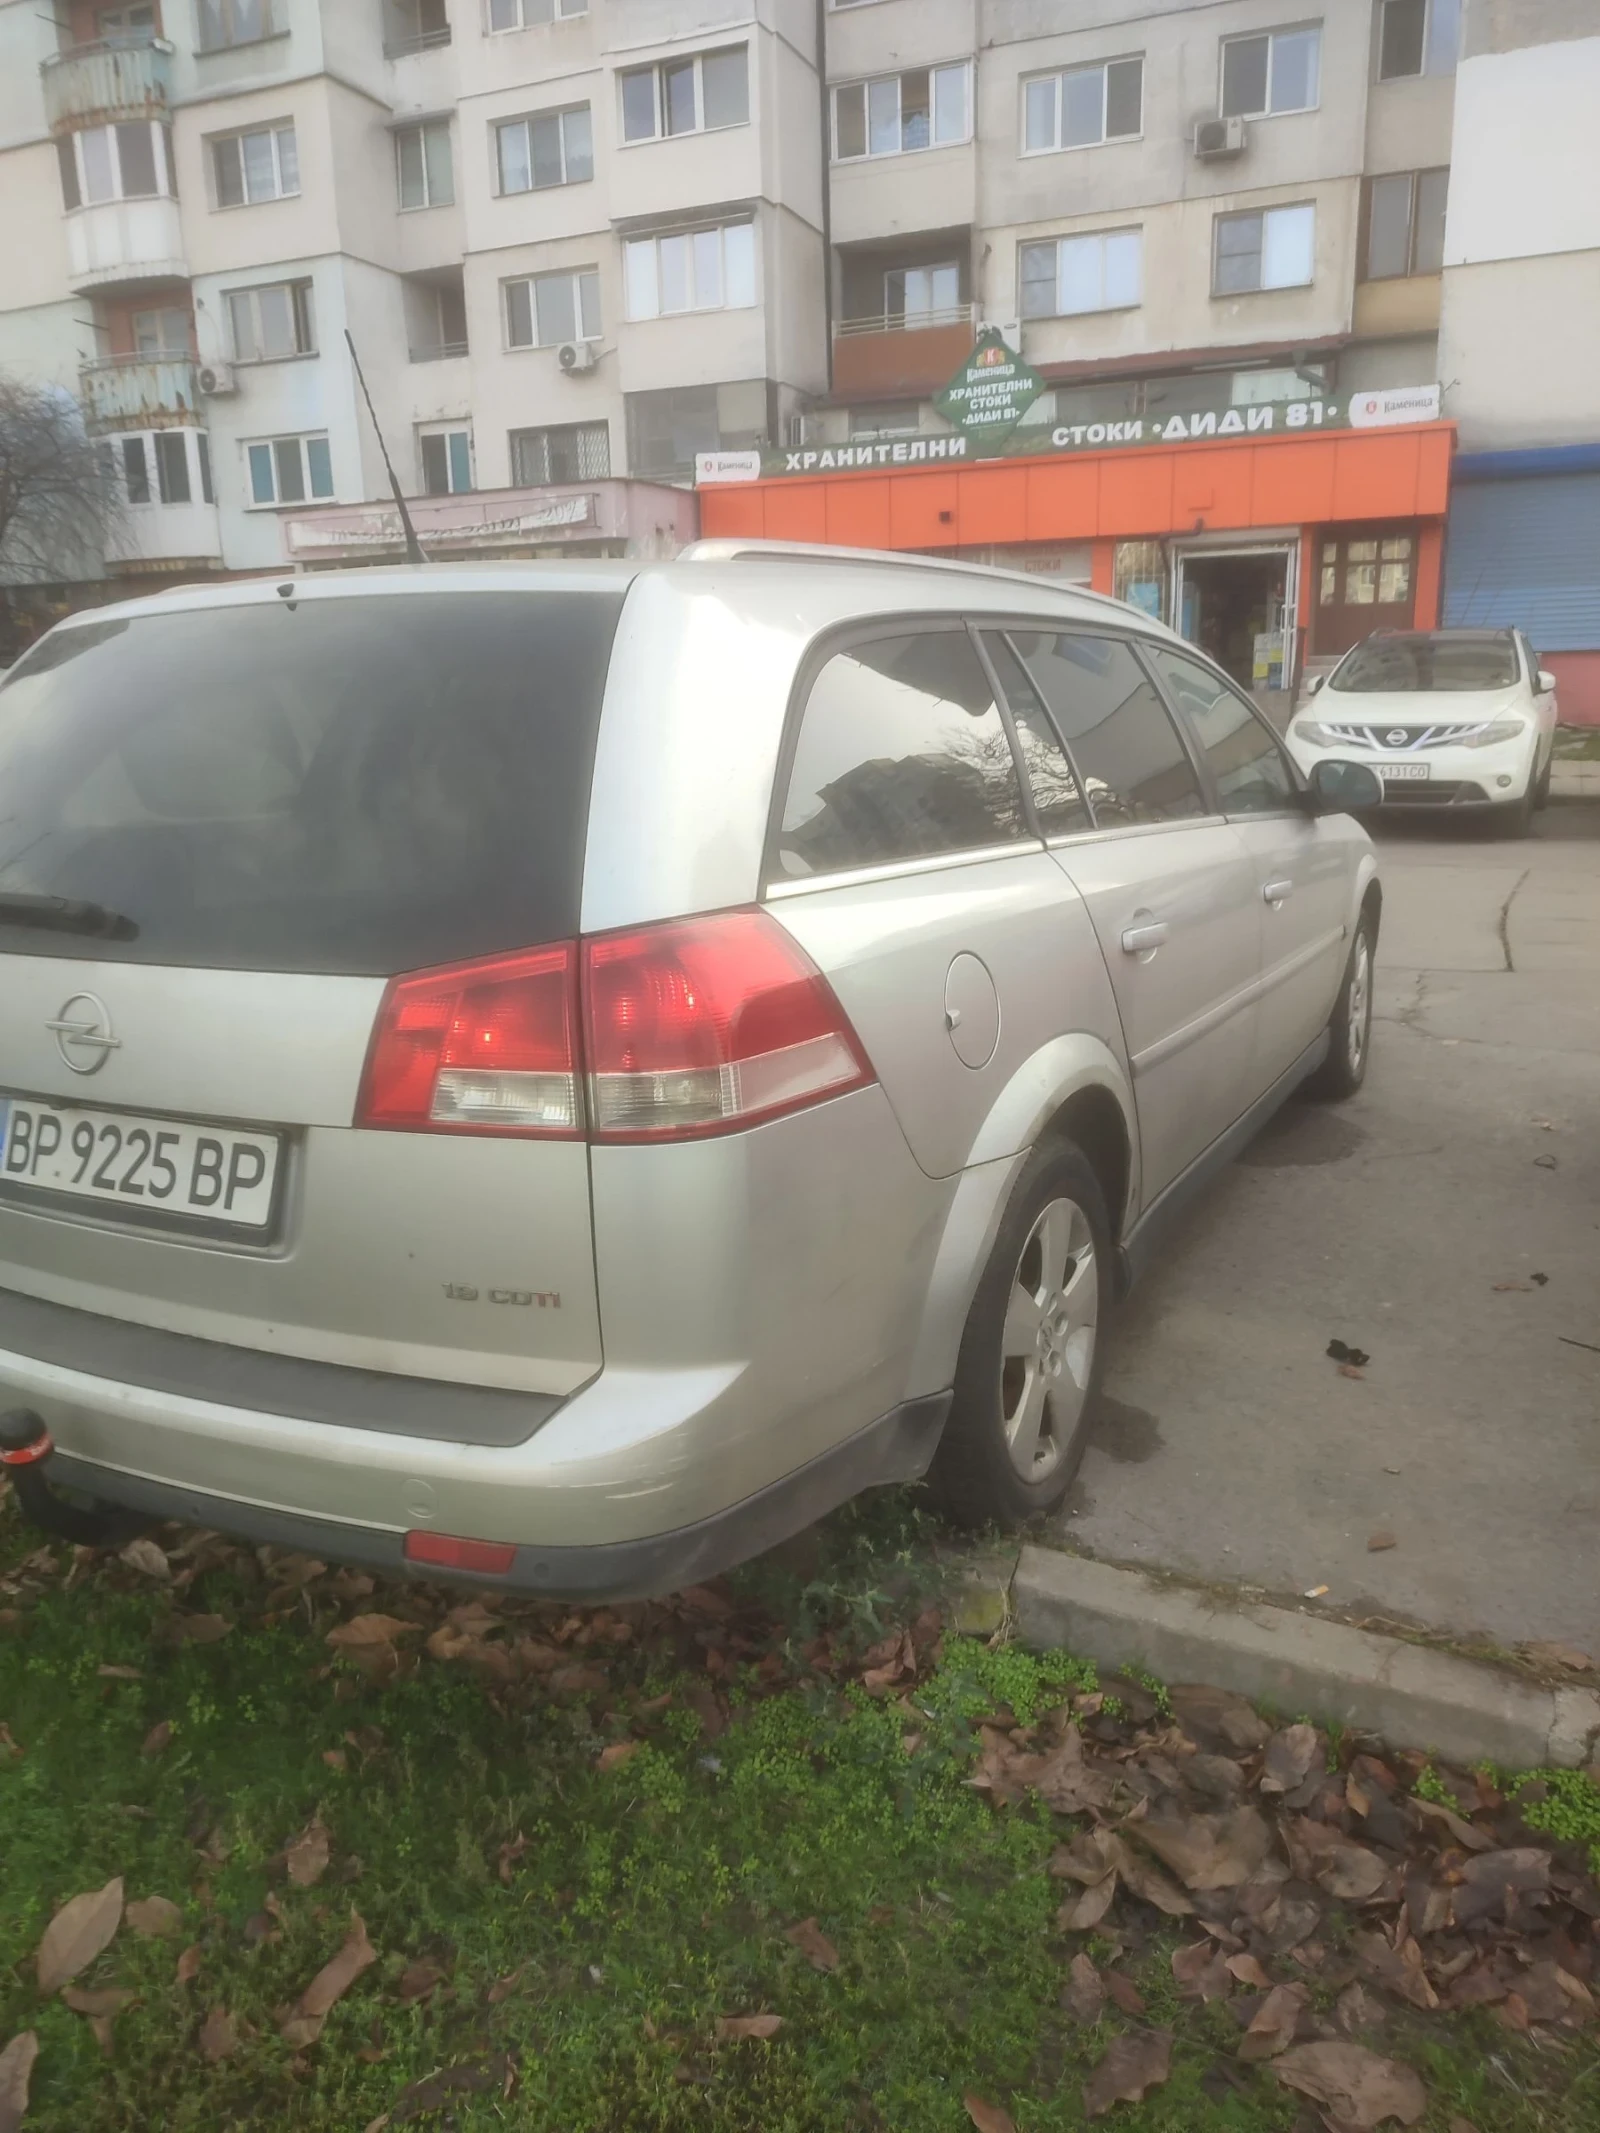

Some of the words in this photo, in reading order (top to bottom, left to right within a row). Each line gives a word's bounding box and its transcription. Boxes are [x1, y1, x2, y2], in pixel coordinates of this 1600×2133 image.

[966, 364, 1015, 382] Каменица
[949, 378, 1033, 401] ХРАНИТЕЛНИ
[970, 394, 1011, 409] СТОКИ
[1384, 398, 1433, 414] Каменица
[786, 437, 966, 471] ХРАНИТЕЛНИ
[1052, 420, 1142, 446] СТОКИ
[69, 1120, 181, 1199] 9225
[487, 1286, 562, 1308] CDTI
